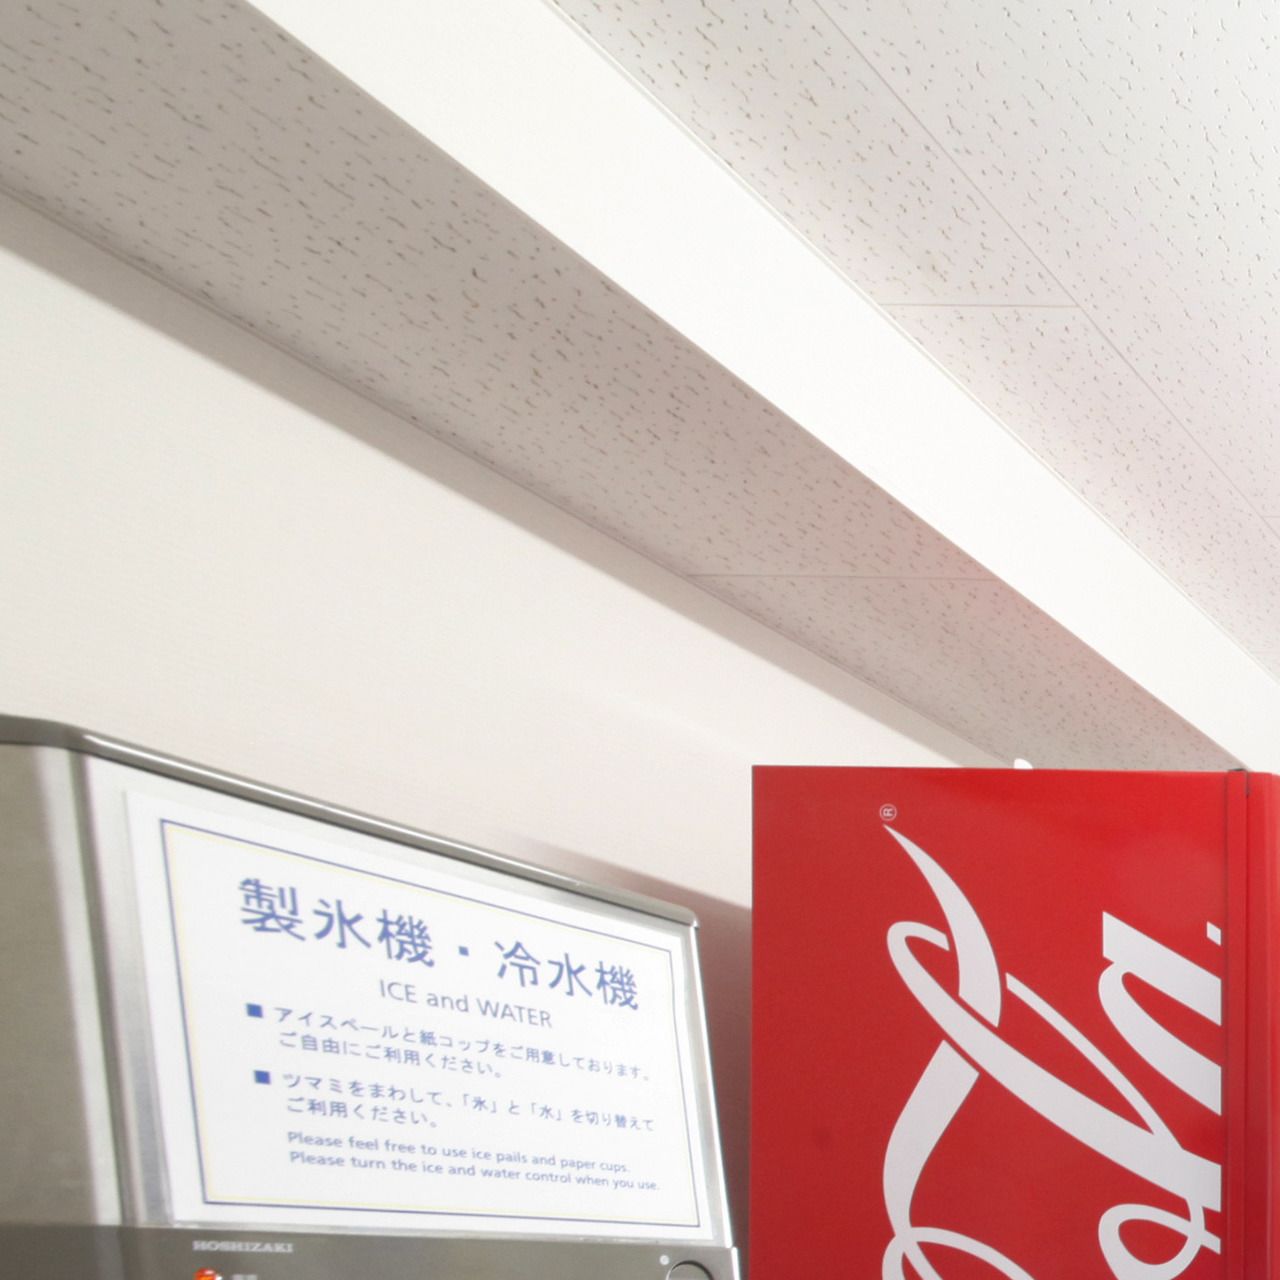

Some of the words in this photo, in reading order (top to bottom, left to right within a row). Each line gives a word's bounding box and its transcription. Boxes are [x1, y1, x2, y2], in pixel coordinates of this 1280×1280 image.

[238, 878, 639, 1011] 製氷機・冷水機
[379, 979, 419, 1004] ICE
[426, 992, 470, 1013] and
[476, 997, 553, 1029] WATER
[287, 1131, 343, 1148] Please
[348, 1135, 379, 1151] feel
[384, 1138, 417, 1154] free
[420, 1143, 438, 1157] to
[442, 1147, 468, 1160] use
[471, 1147, 492, 1161] ice
[496, 1151, 528, 1166] pails
[532, 1154, 556, 1167] and
[560, 1157, 596, 1172] paper
[289, 1150, 345, 1167] Please
[350, 1156, 386, 1170] turn
[391, 1158, 418, 1172] the
[421, 1161, 444, 1175] ice
[448, 1164, 477, 1177] and
[480, 1167, 521, 1181] water
[525, 1170, 572, 1185] control
[575, 1174, 609, 1187] when
[612, 1178, 634, 1190] you
[191, 1239, 294, 1254] HOSHIZAKI
